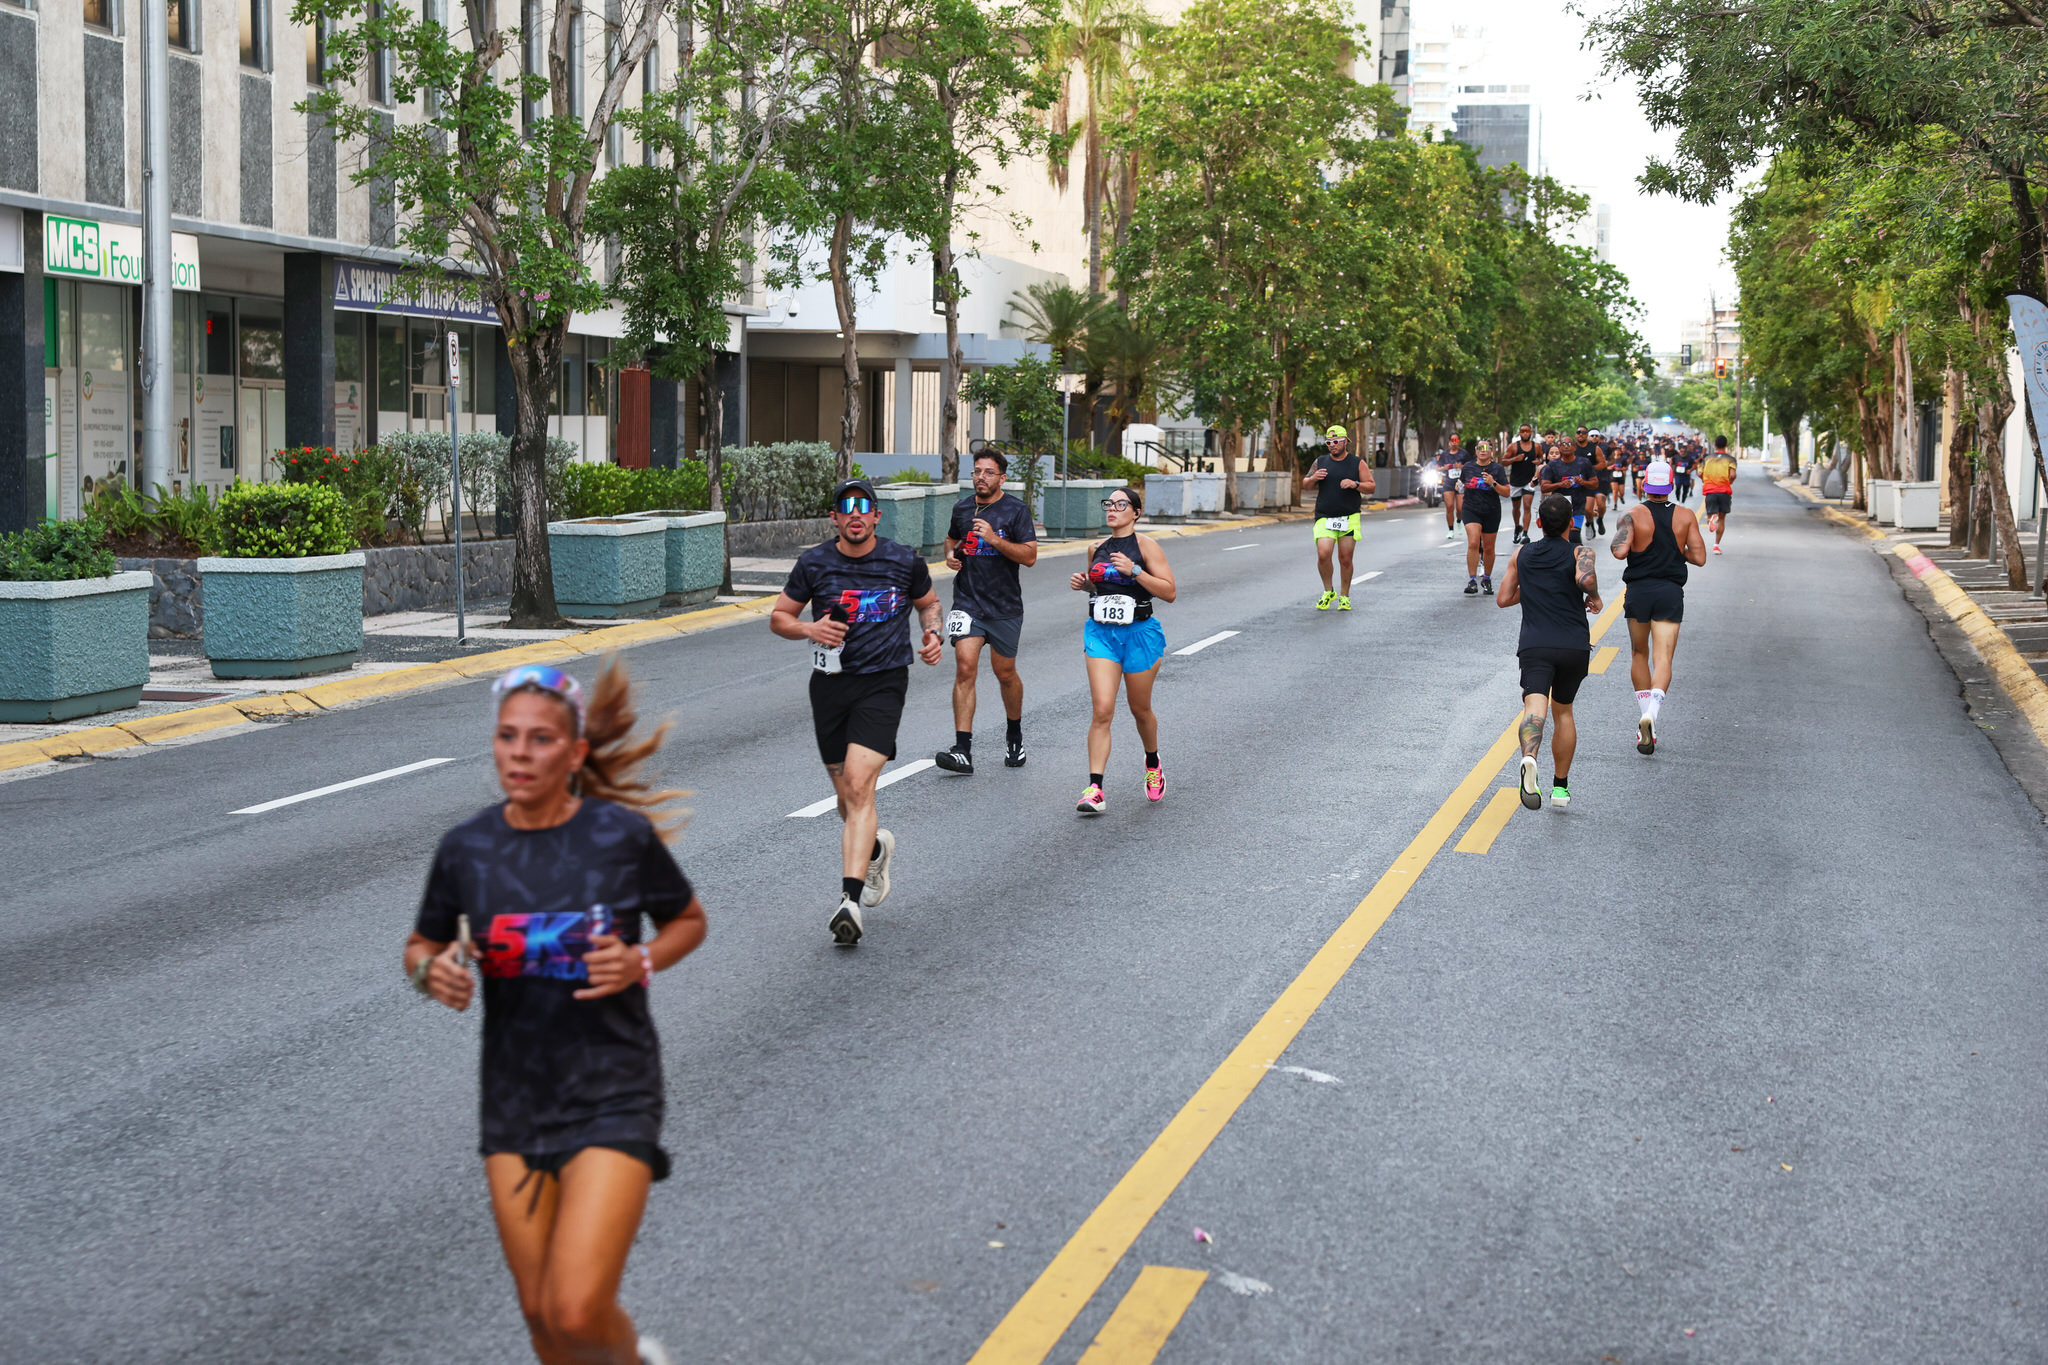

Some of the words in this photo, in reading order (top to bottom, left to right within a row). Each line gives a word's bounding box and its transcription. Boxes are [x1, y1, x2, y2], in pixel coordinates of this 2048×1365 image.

[48, 219, 98, 272] MCS
[110, 240, 197, 288] Fouion
[350, 267, 376, 303] SPACE
[1332, 521, 1342, 529] 69
[839, 589, 889, 613] 5K
[1102, 606, 1125, 620] 183
[948, 621, 963, 632] 182
[814, 650, 826, 668] 13
[486, 911, 586, 960] 5K
